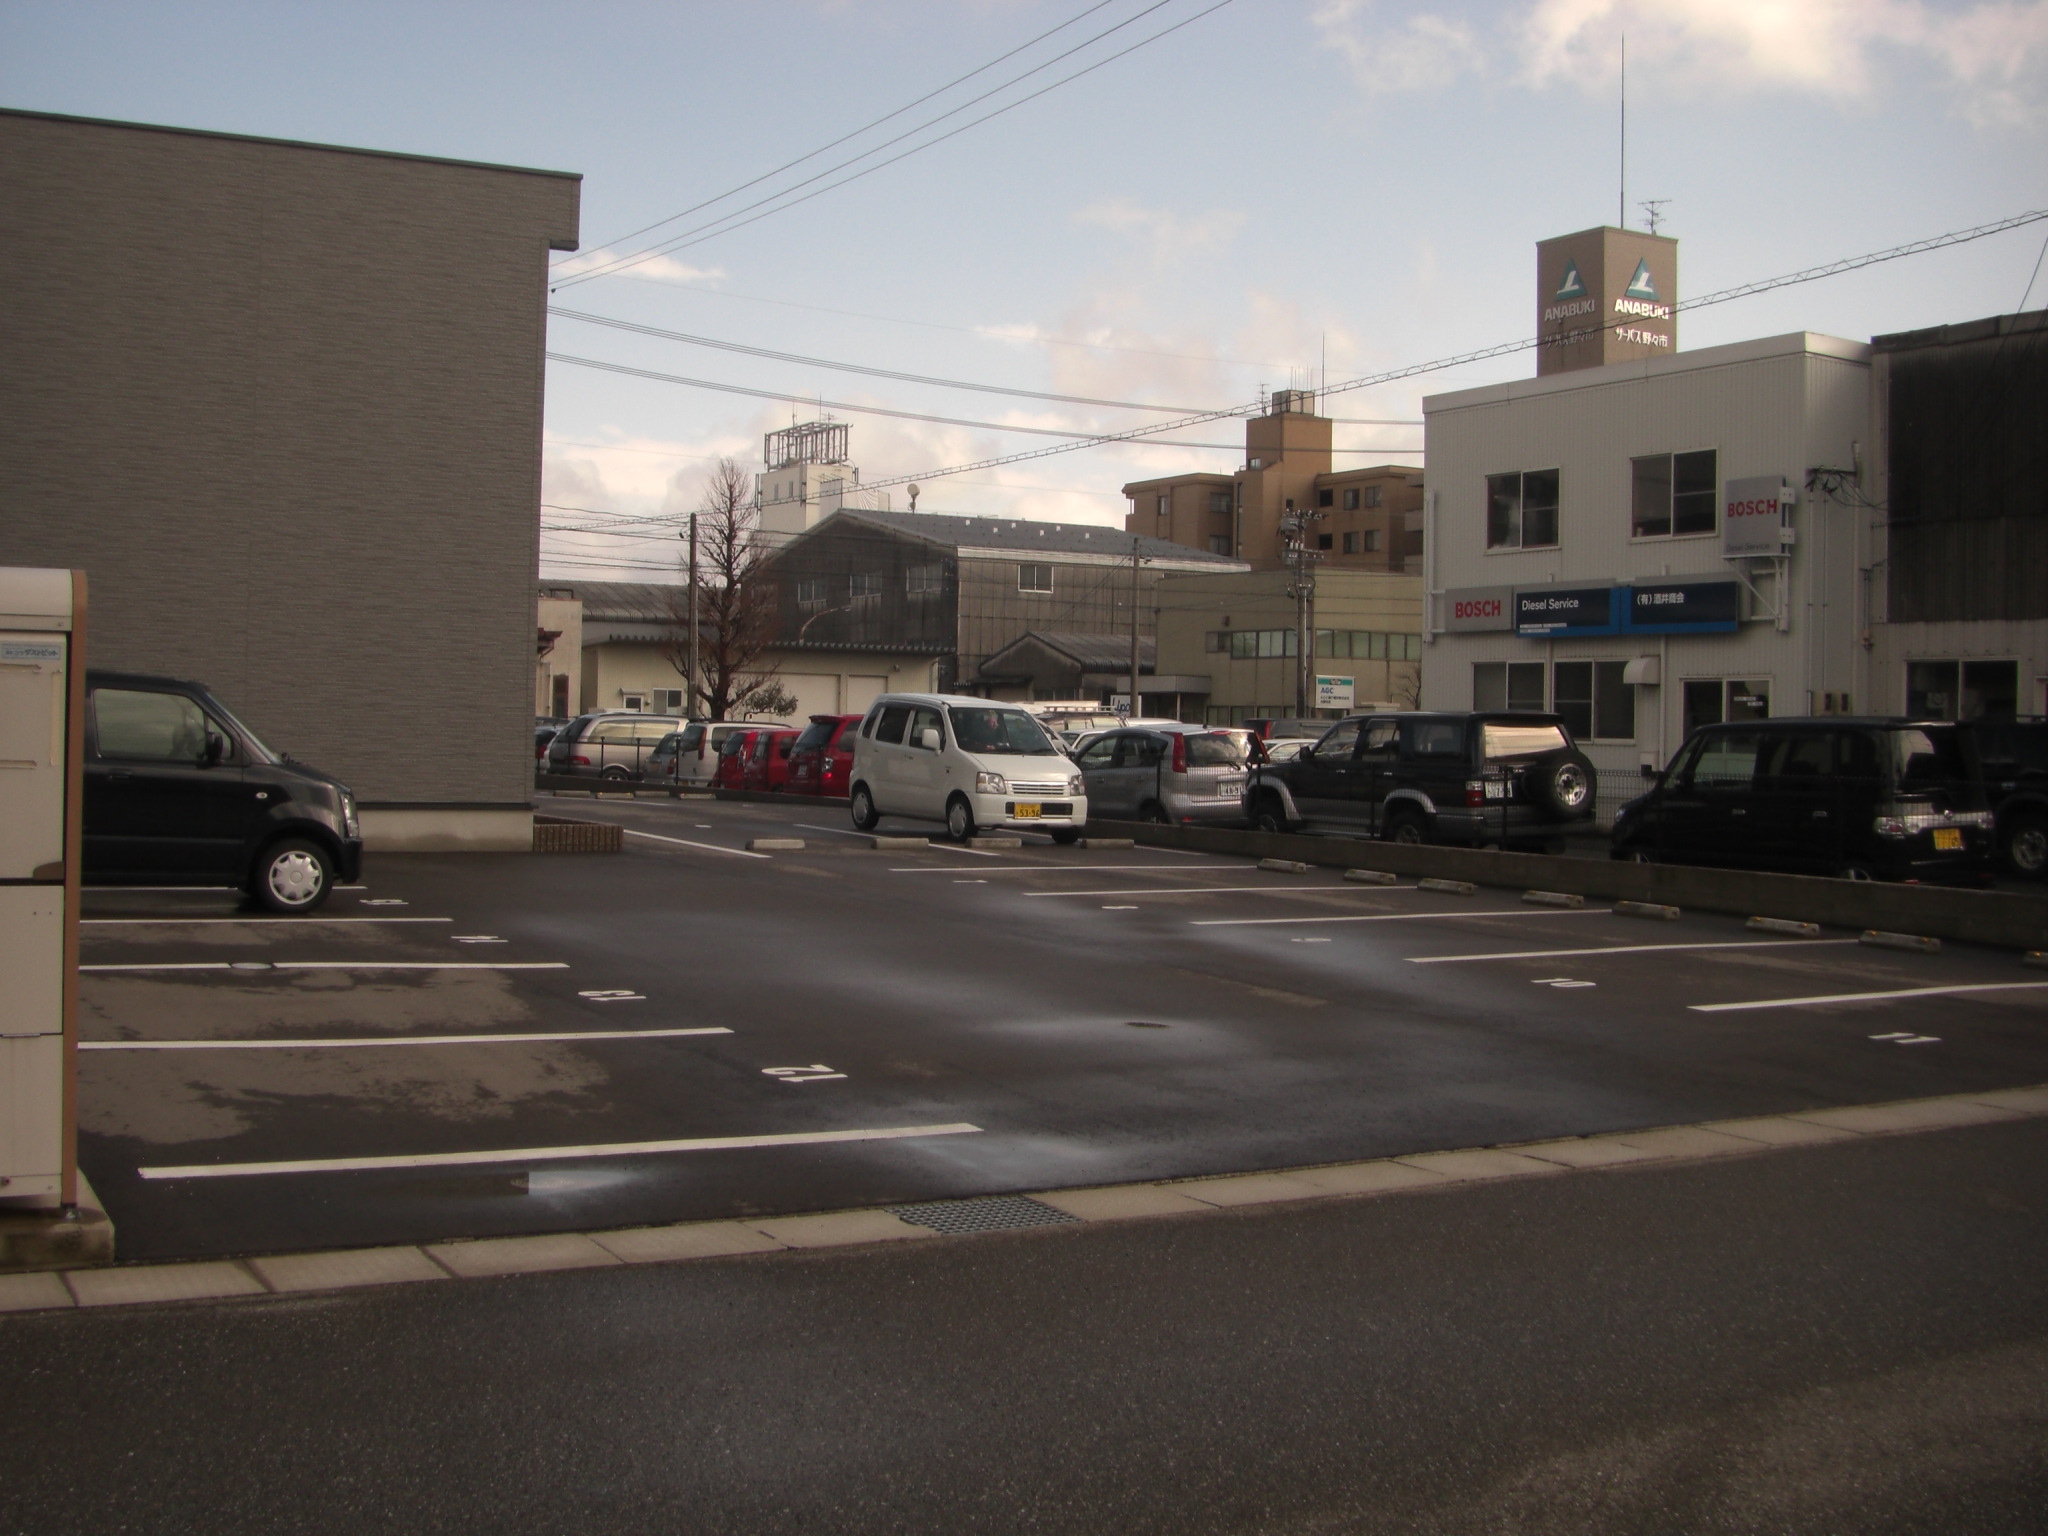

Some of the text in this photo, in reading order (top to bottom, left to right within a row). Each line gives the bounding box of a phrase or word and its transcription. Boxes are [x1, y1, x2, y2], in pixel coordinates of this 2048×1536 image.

[1544, 300, 1595, 322] ANABUKI
[1614, 299, 1669, 320] ANABUKI
[1727, 499, 1778, 518] BOSCH
[1455, 600, 1502, 619] BOSCH
[1521, 597, 1579, 611] Diesel Service
[762, 1064, 848, 1082] 12
